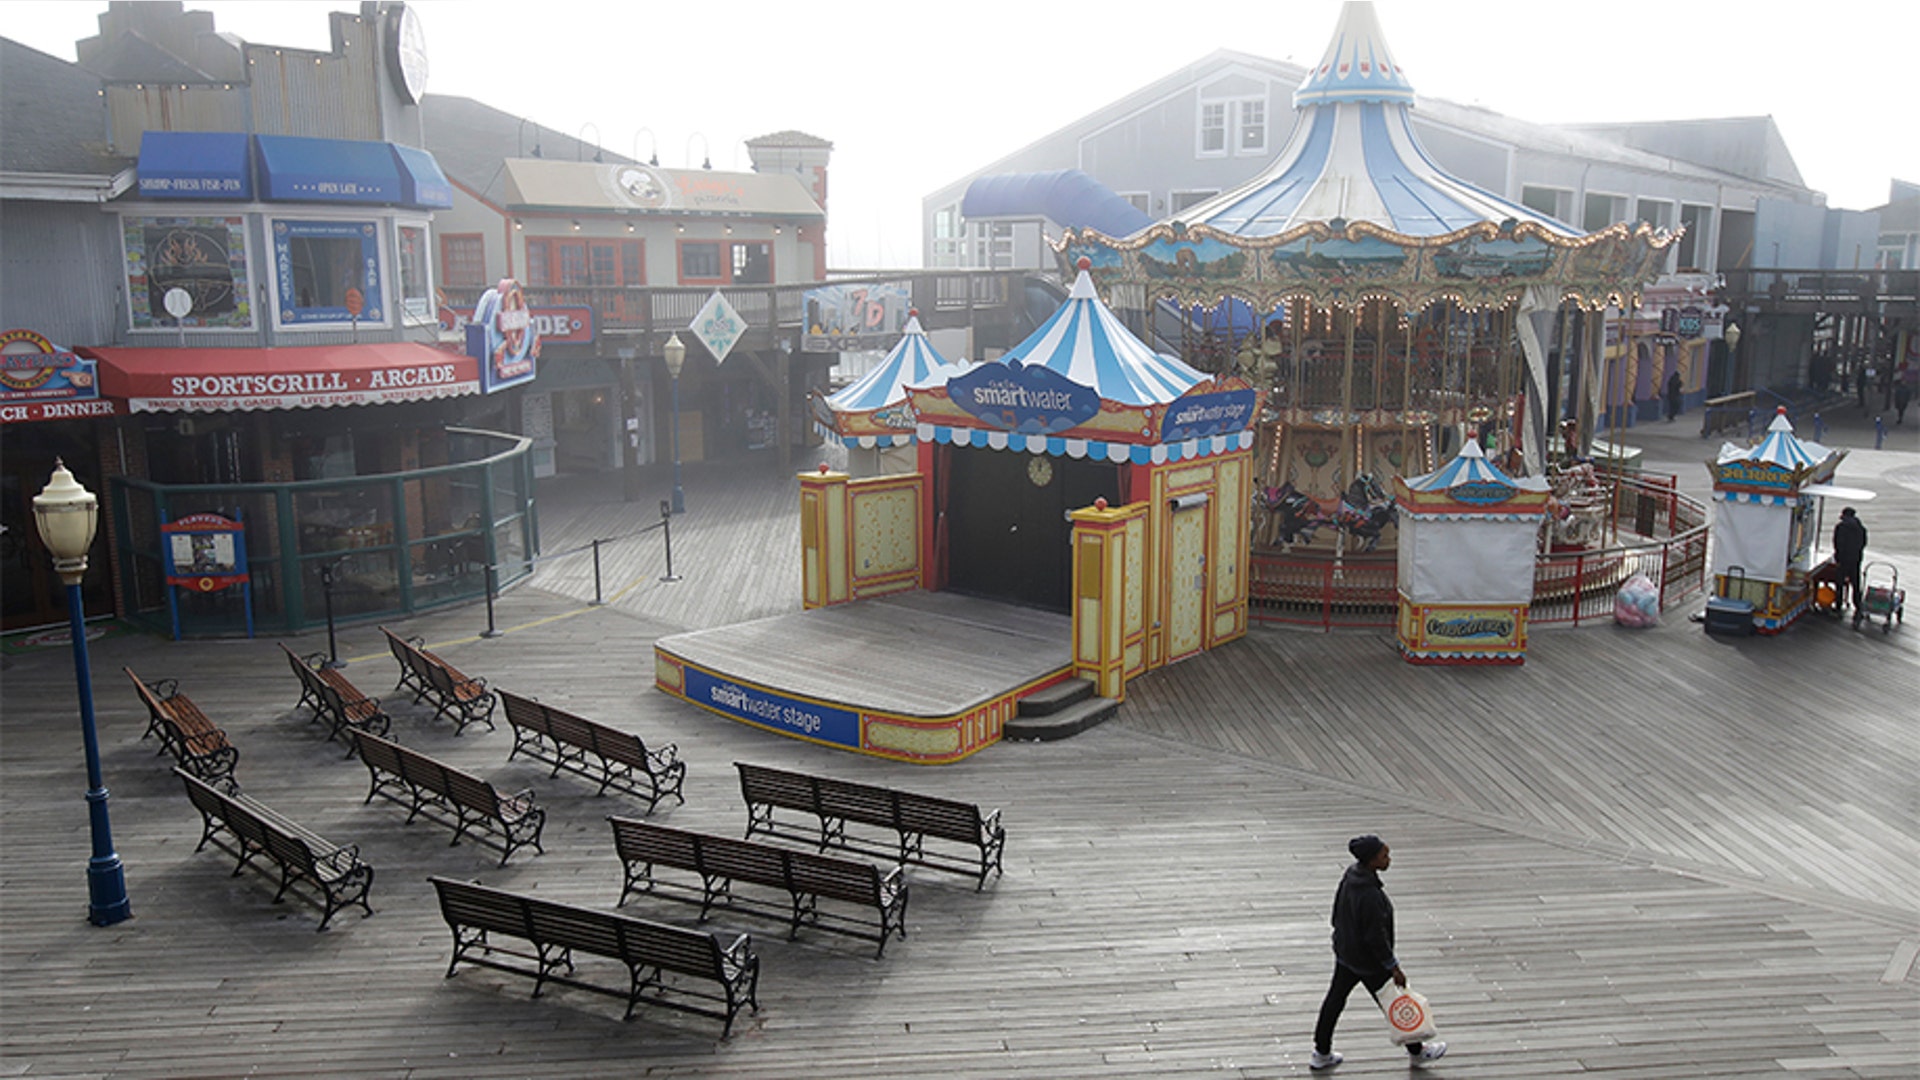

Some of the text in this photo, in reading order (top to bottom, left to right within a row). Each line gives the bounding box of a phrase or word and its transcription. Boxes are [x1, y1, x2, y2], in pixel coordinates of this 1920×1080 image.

[318, 182, 358, 195] OPEN LATE
[277, 243, 290, 301] MARKET
[367, 257, 377, 287] BAR
[852, 288, 884, 327] 7D
[0, 352, 64, 370] AYERS
[171, 364, 456, 397] SPORTSGRILL ARCADE
[1, 400, 115, 421] CH DINNER
[148, 400, 185, 408] FAMILY
[189, 400, 228, 408] DINING
[244, 398, 283, 408] GAMES
[301, 393, 365, 405] LIVE SPORTS
[974, 385, 1073, 411] smartwater
[710, 685, 821, 733] smartwater stage
